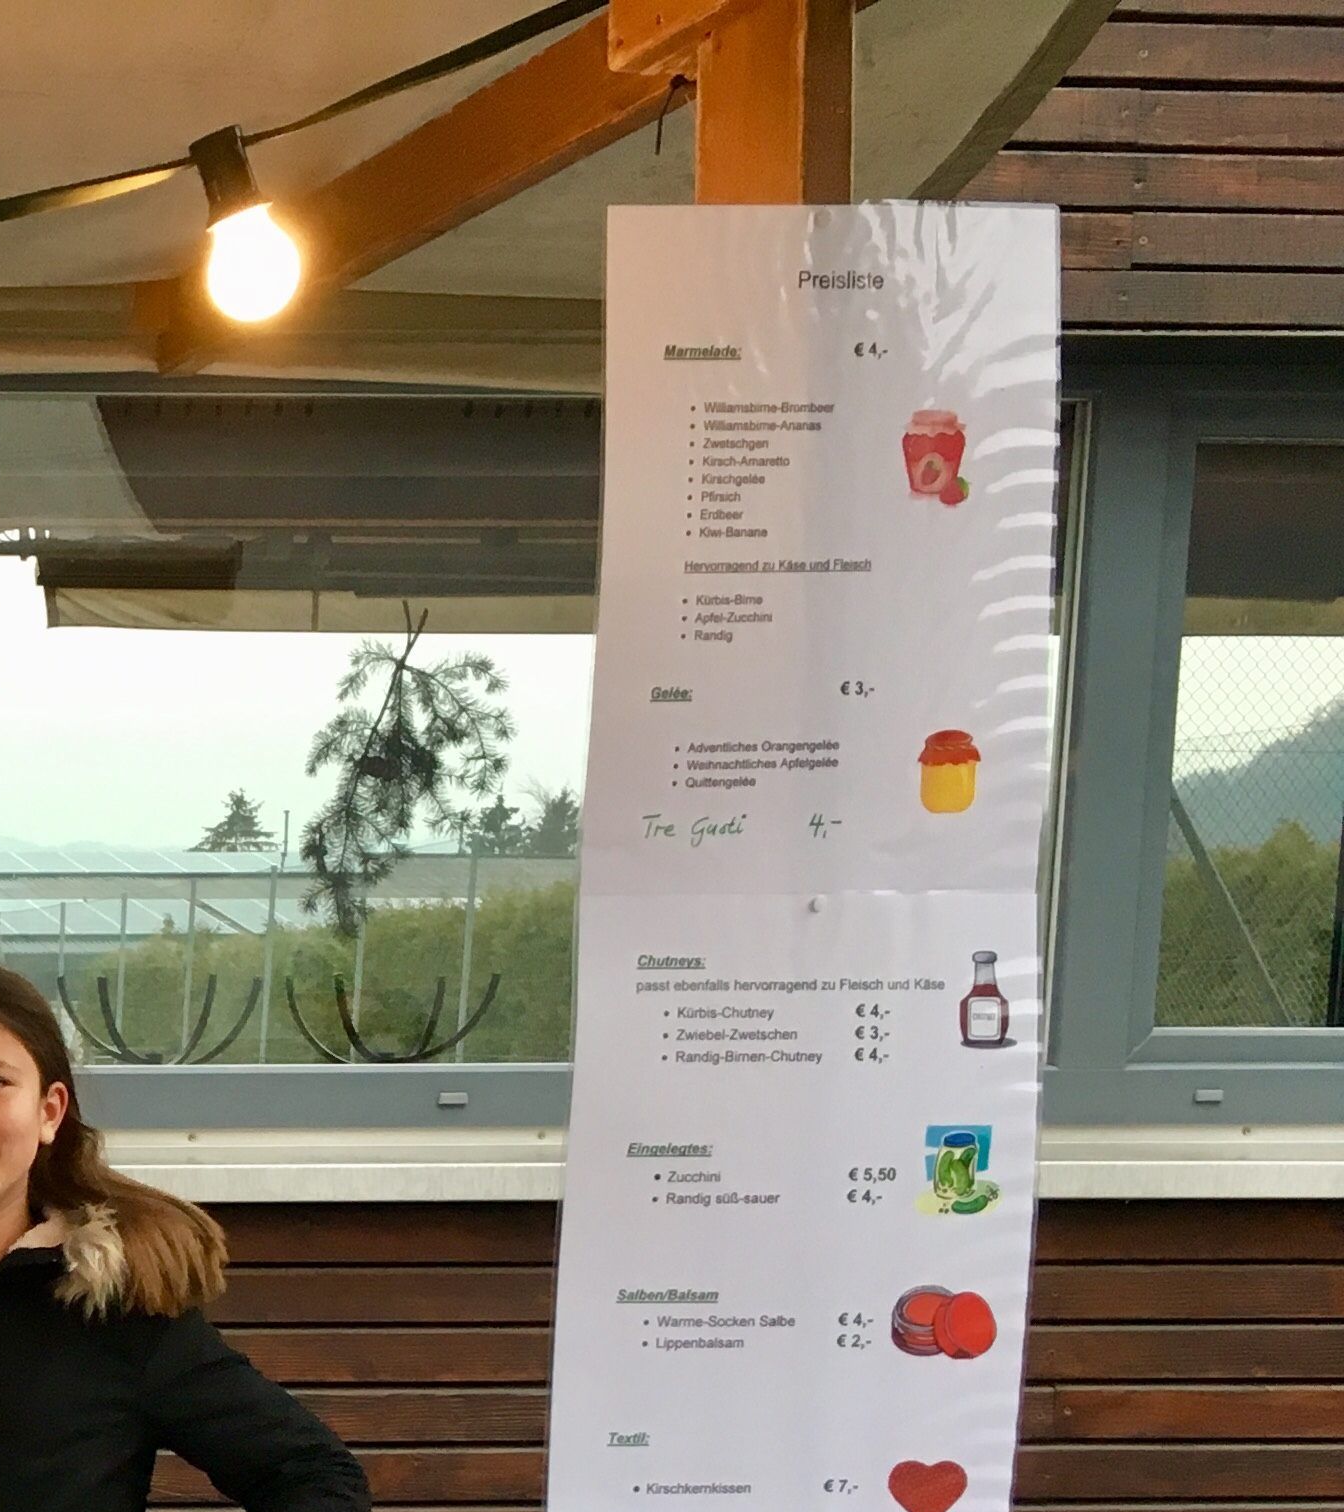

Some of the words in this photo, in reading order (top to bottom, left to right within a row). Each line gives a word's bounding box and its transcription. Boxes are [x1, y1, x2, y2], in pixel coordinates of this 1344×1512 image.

[799, 271, 884, 289] Preisliste
[664, 345, 741, 360] Marmelade:
[854, 343, 864, 357] €
[869, 342, 888, 359] 4,-
[704, 420, 822, 431] Williamsbirne-Ananas
[703, 438, 769, 451] Zwetschgen
[703, 456, 790, 467] Kirsch-Amaretto
[701, 491, 741, 502] Pfirsich
[700, 509, 743, 520] Erdbeer
[699, 526, 768, 538] Kiwi-Banane
[684, 560, 760, 574] Hervorragend
[762, 561, 775, 573] zu
[778, 560, 806, 573] Käse
[809, 559, 830, 572] und
[833, 559, 871, 572] Fleisch
[696, 594, 763, 605] Kürbis-Birne
[695, 612, 772, 625] Apfel-Zucchini
[695, 630, 733, 643] Randig
[650, 687, 693, 702] Gelée:
[840, 681, 850, 695] €
[855, 681, 874, 697] 3,-
[687, 742, 758, 753] Adventliches
[687, 759, 777, 770] Weihnachtliches
[642, 814, 675, 838] Tre
[691, 814, 747, 847] Gusti
[809, 814, 842, 838] 4,-
[637, 955, 705, 970] Chutneys:
[636, 981, 670, 994] passt
[673, 979, 730, 991] ebenfalls
[734, 979, 817, 993] hervorragend
[821, 981, 836, 990] zu
[840, 978, 883, 990] Fleisch
[888, 979, 910, 990] und
[914, 979, 945, 990] Käse
[677, 1006, 774, 1021] Kürbis-Chutney
[856, 1004, 865, 1017] €
[870, 1004, 890, 1019] 4,-
[676, 1029, 797, 1040] Zwiebel-Zwetschen
[855, 1026, 864, 1040] €
[870, 1026, 889, 1042] 3,-
[676, 1050, 822, 1065] Randig-Birnen-Chutney
[855, 1048, 864, 1061] €
[869, 1048, 888, 1063] 4,-
[627, 1143, 713, 1157] Eingelegtes:
[667, 1171, 721, 1183] Zucchini
[849, 1168, 858, 1181] €
[864, 1168, 896, 1183] 5,50
[666, 1192, 711, 1207] Randig
[716, 1192, 780, 1204] süß-sauer
[847, 1189, 857, 1203] €
[862, 1190, 882, 1205] 4,-
[616, 1289, 719, 1304] Salben/Balsam
[657, 1315, 755, 1327] Warme-Socken
[760, 1315, 795, 1327] Salbe
[838, 1313, 848, 1326] €
[853, 1313, 873, 1328] 4,-
[656, 1338, 744, 1351] Lippenbalsam
[837, 1334, 846, 1347] €
[851, 1334, 871, 1349] 2,-
[607, 1432, 650, 1447] Textil:
[647, 1483, 751, 1494] Kirschkernkissen
[824, 1479, 834, 1492] €
[839, 1479, 858, 1494] 7,-
